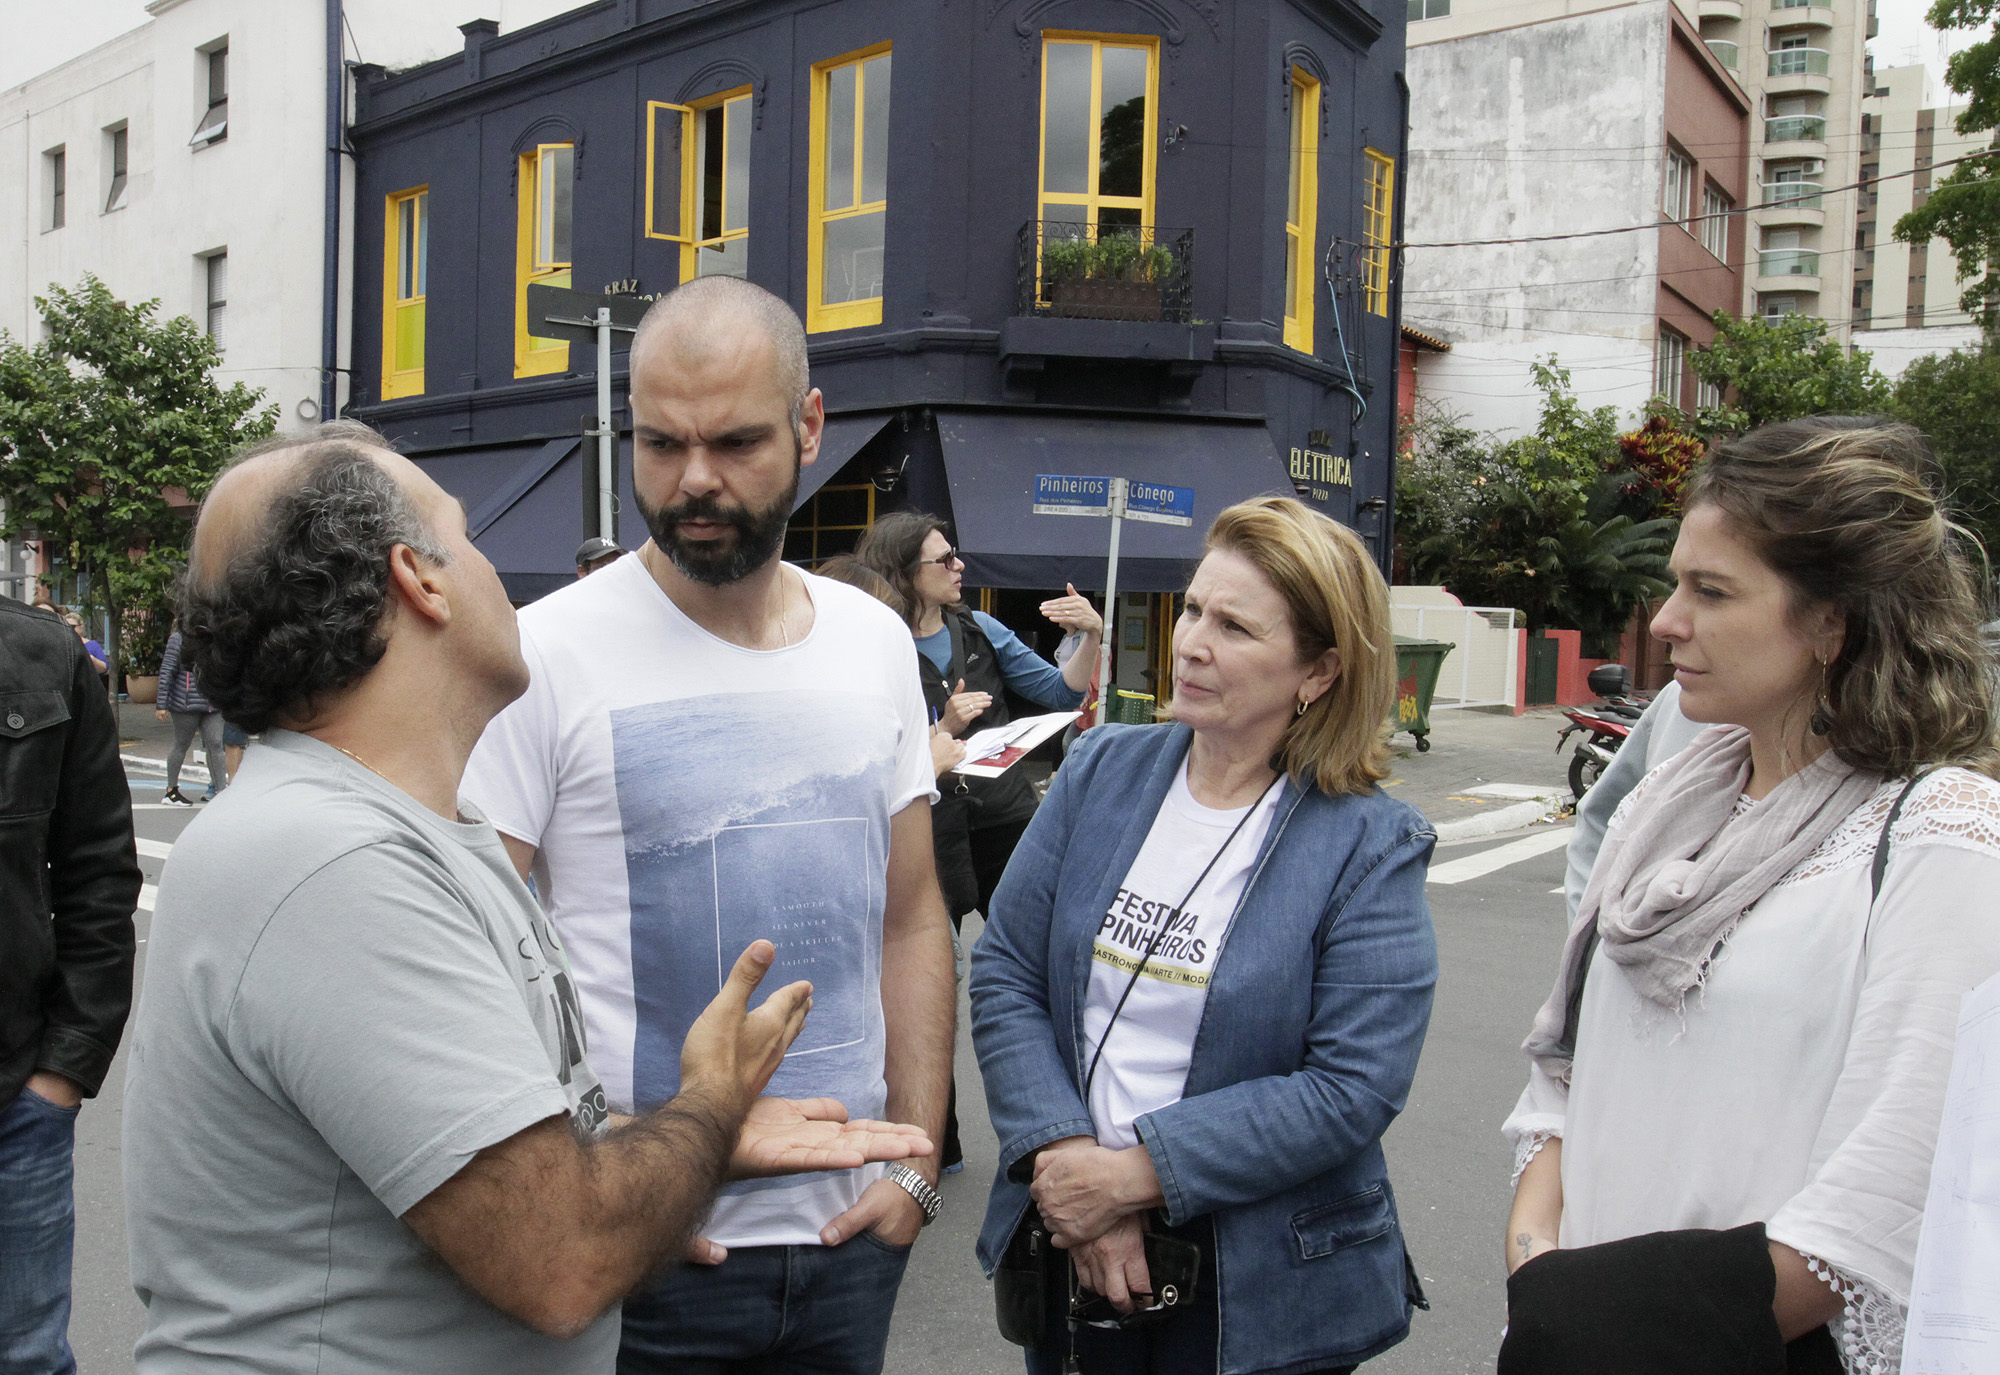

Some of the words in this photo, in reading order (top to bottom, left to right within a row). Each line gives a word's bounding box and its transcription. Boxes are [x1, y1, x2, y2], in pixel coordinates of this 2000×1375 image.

[1290, 447, 1352, 488] ELETTRICA
[1039, 477, 1104, 494] Pinheiros
[1130, 483, 1175, 506] Cônego
[1312, 488, 1329, 501] PIZZA
[782, 901, 825, 911] SMOOTH
[1109, 888, 1199, 936] FESTIVA
[772, 923, 788, 931] SEA
[793, 919, 827, 929] NEVER
[1097, 912, 1207, 964] PINHEIROS
[781, 957, 816, 966] SAILOR
[1154, 966, 1173, 979] ARTE
